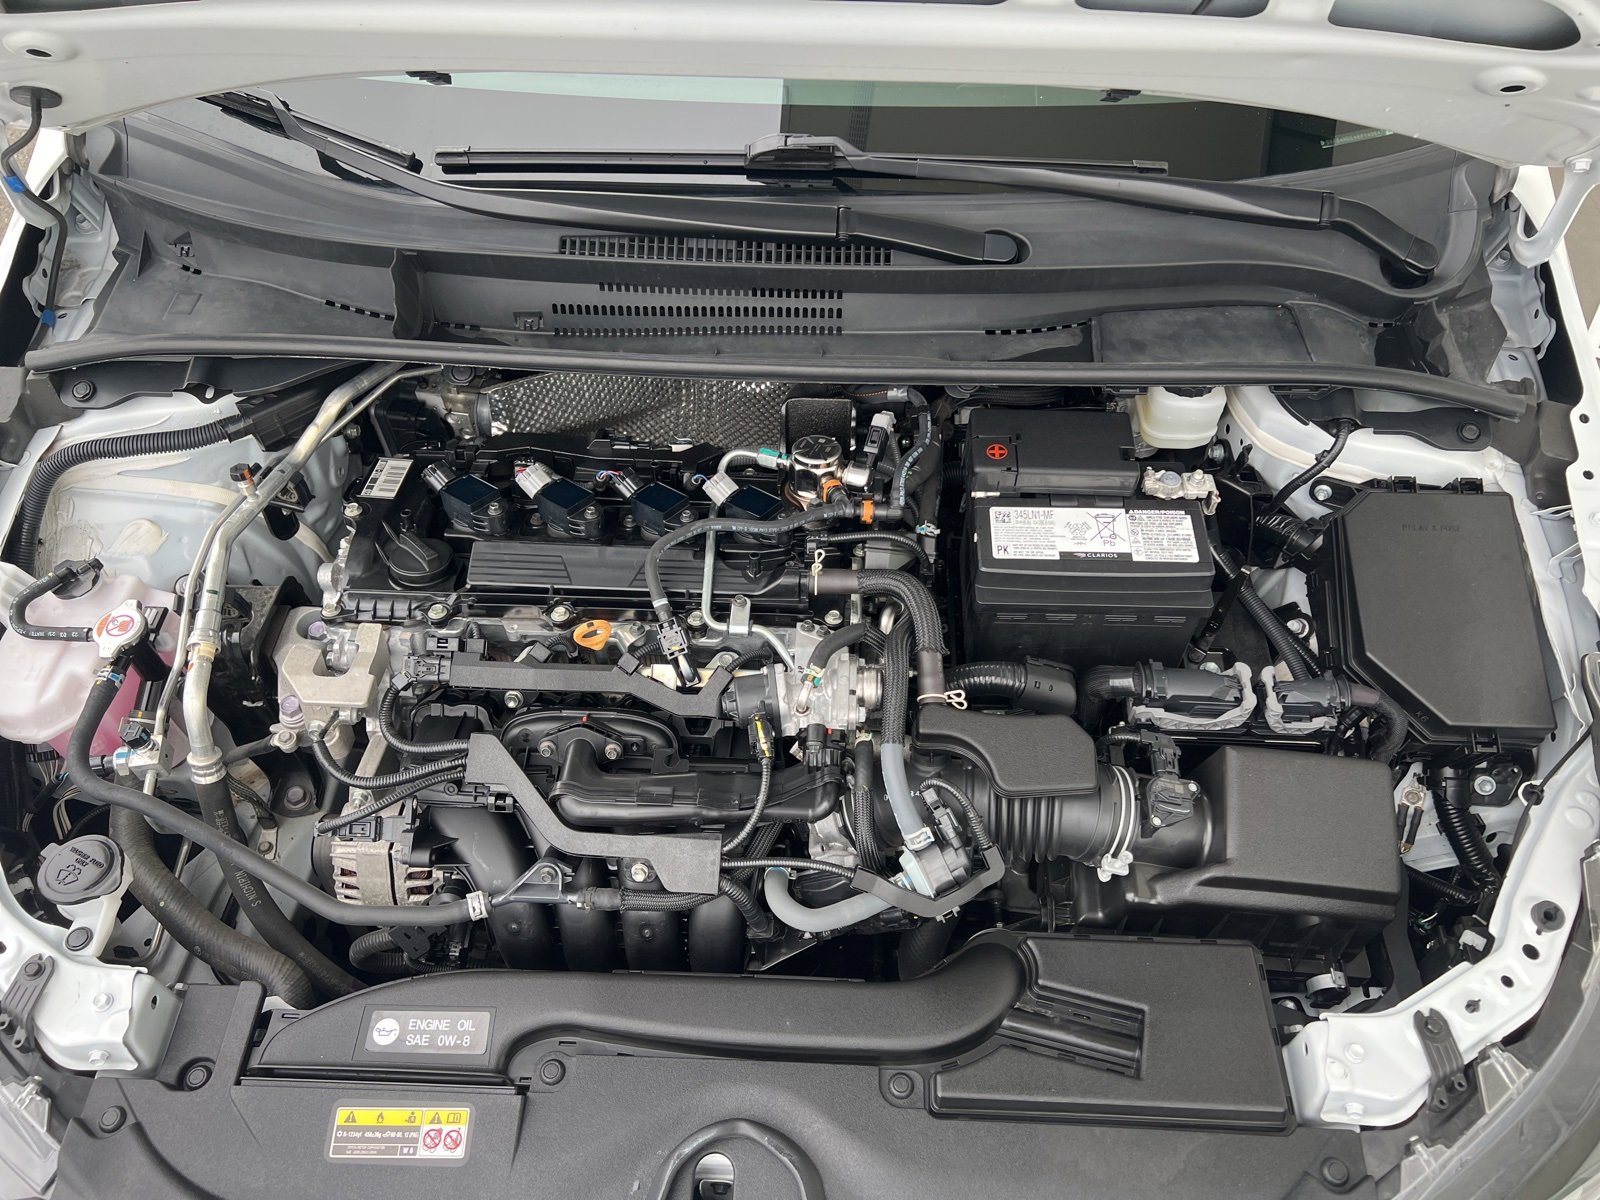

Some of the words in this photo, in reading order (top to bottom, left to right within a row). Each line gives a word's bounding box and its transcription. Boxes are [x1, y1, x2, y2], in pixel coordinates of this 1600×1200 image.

[996, 545, 1009, 555] PK
[408, 1019, 450, 1031] ENGINE
[457, 1019, 476, 1031] OIL
[405, 1034, 430, 1046] SAE
[437, 1035, 470, 1047] 0W-8
